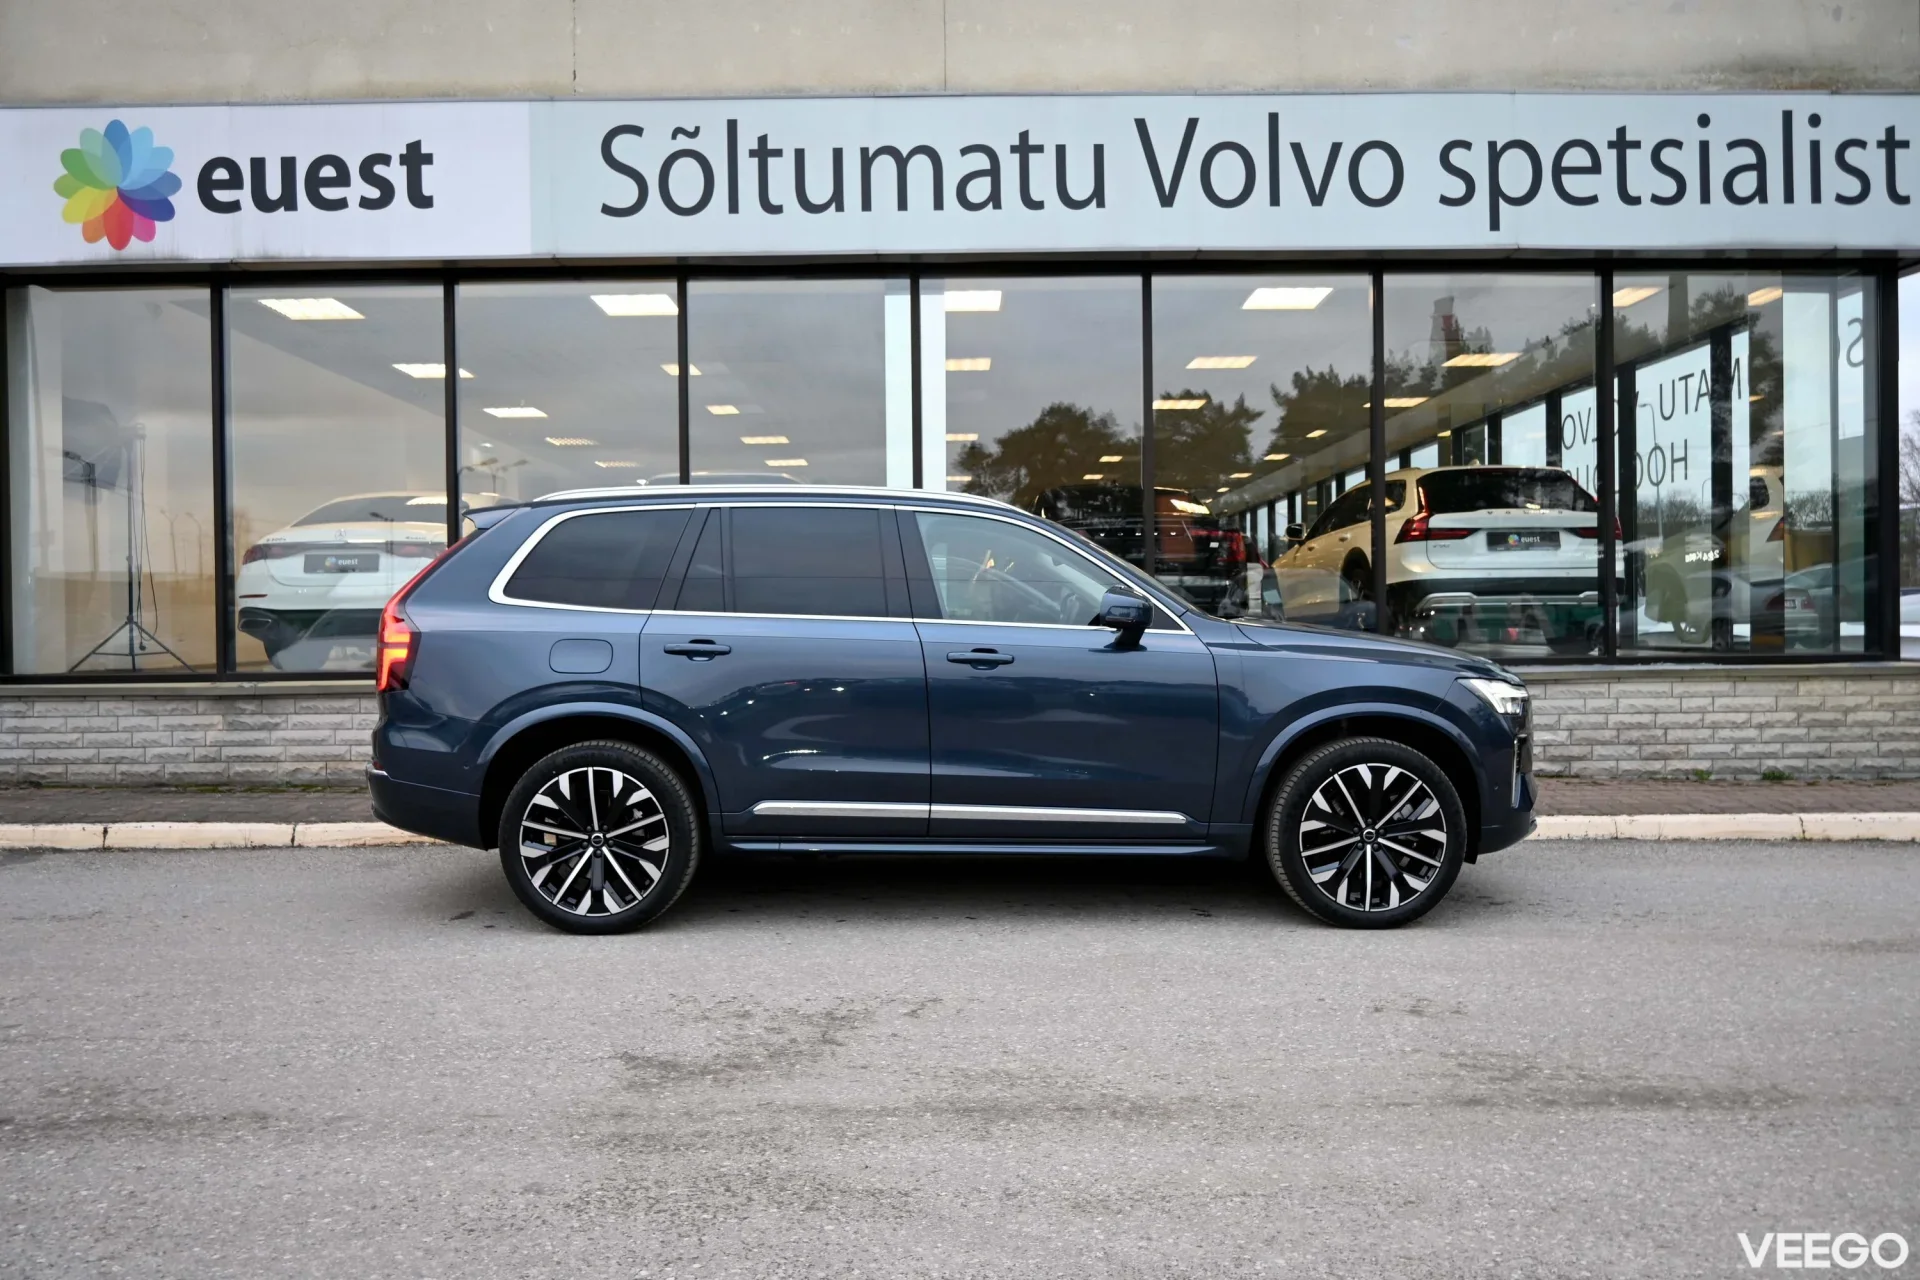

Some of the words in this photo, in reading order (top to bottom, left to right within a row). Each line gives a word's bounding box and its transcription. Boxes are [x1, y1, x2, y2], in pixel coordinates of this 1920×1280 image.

[197, 139, 434, 214] euest
[600, 119, 1106, 218] Sõltumatu
[1133, 112, 1405, 209] Volvo
[1438, 109, 1912, 232] spetsialist
[338, 558, 358, 566] euest
